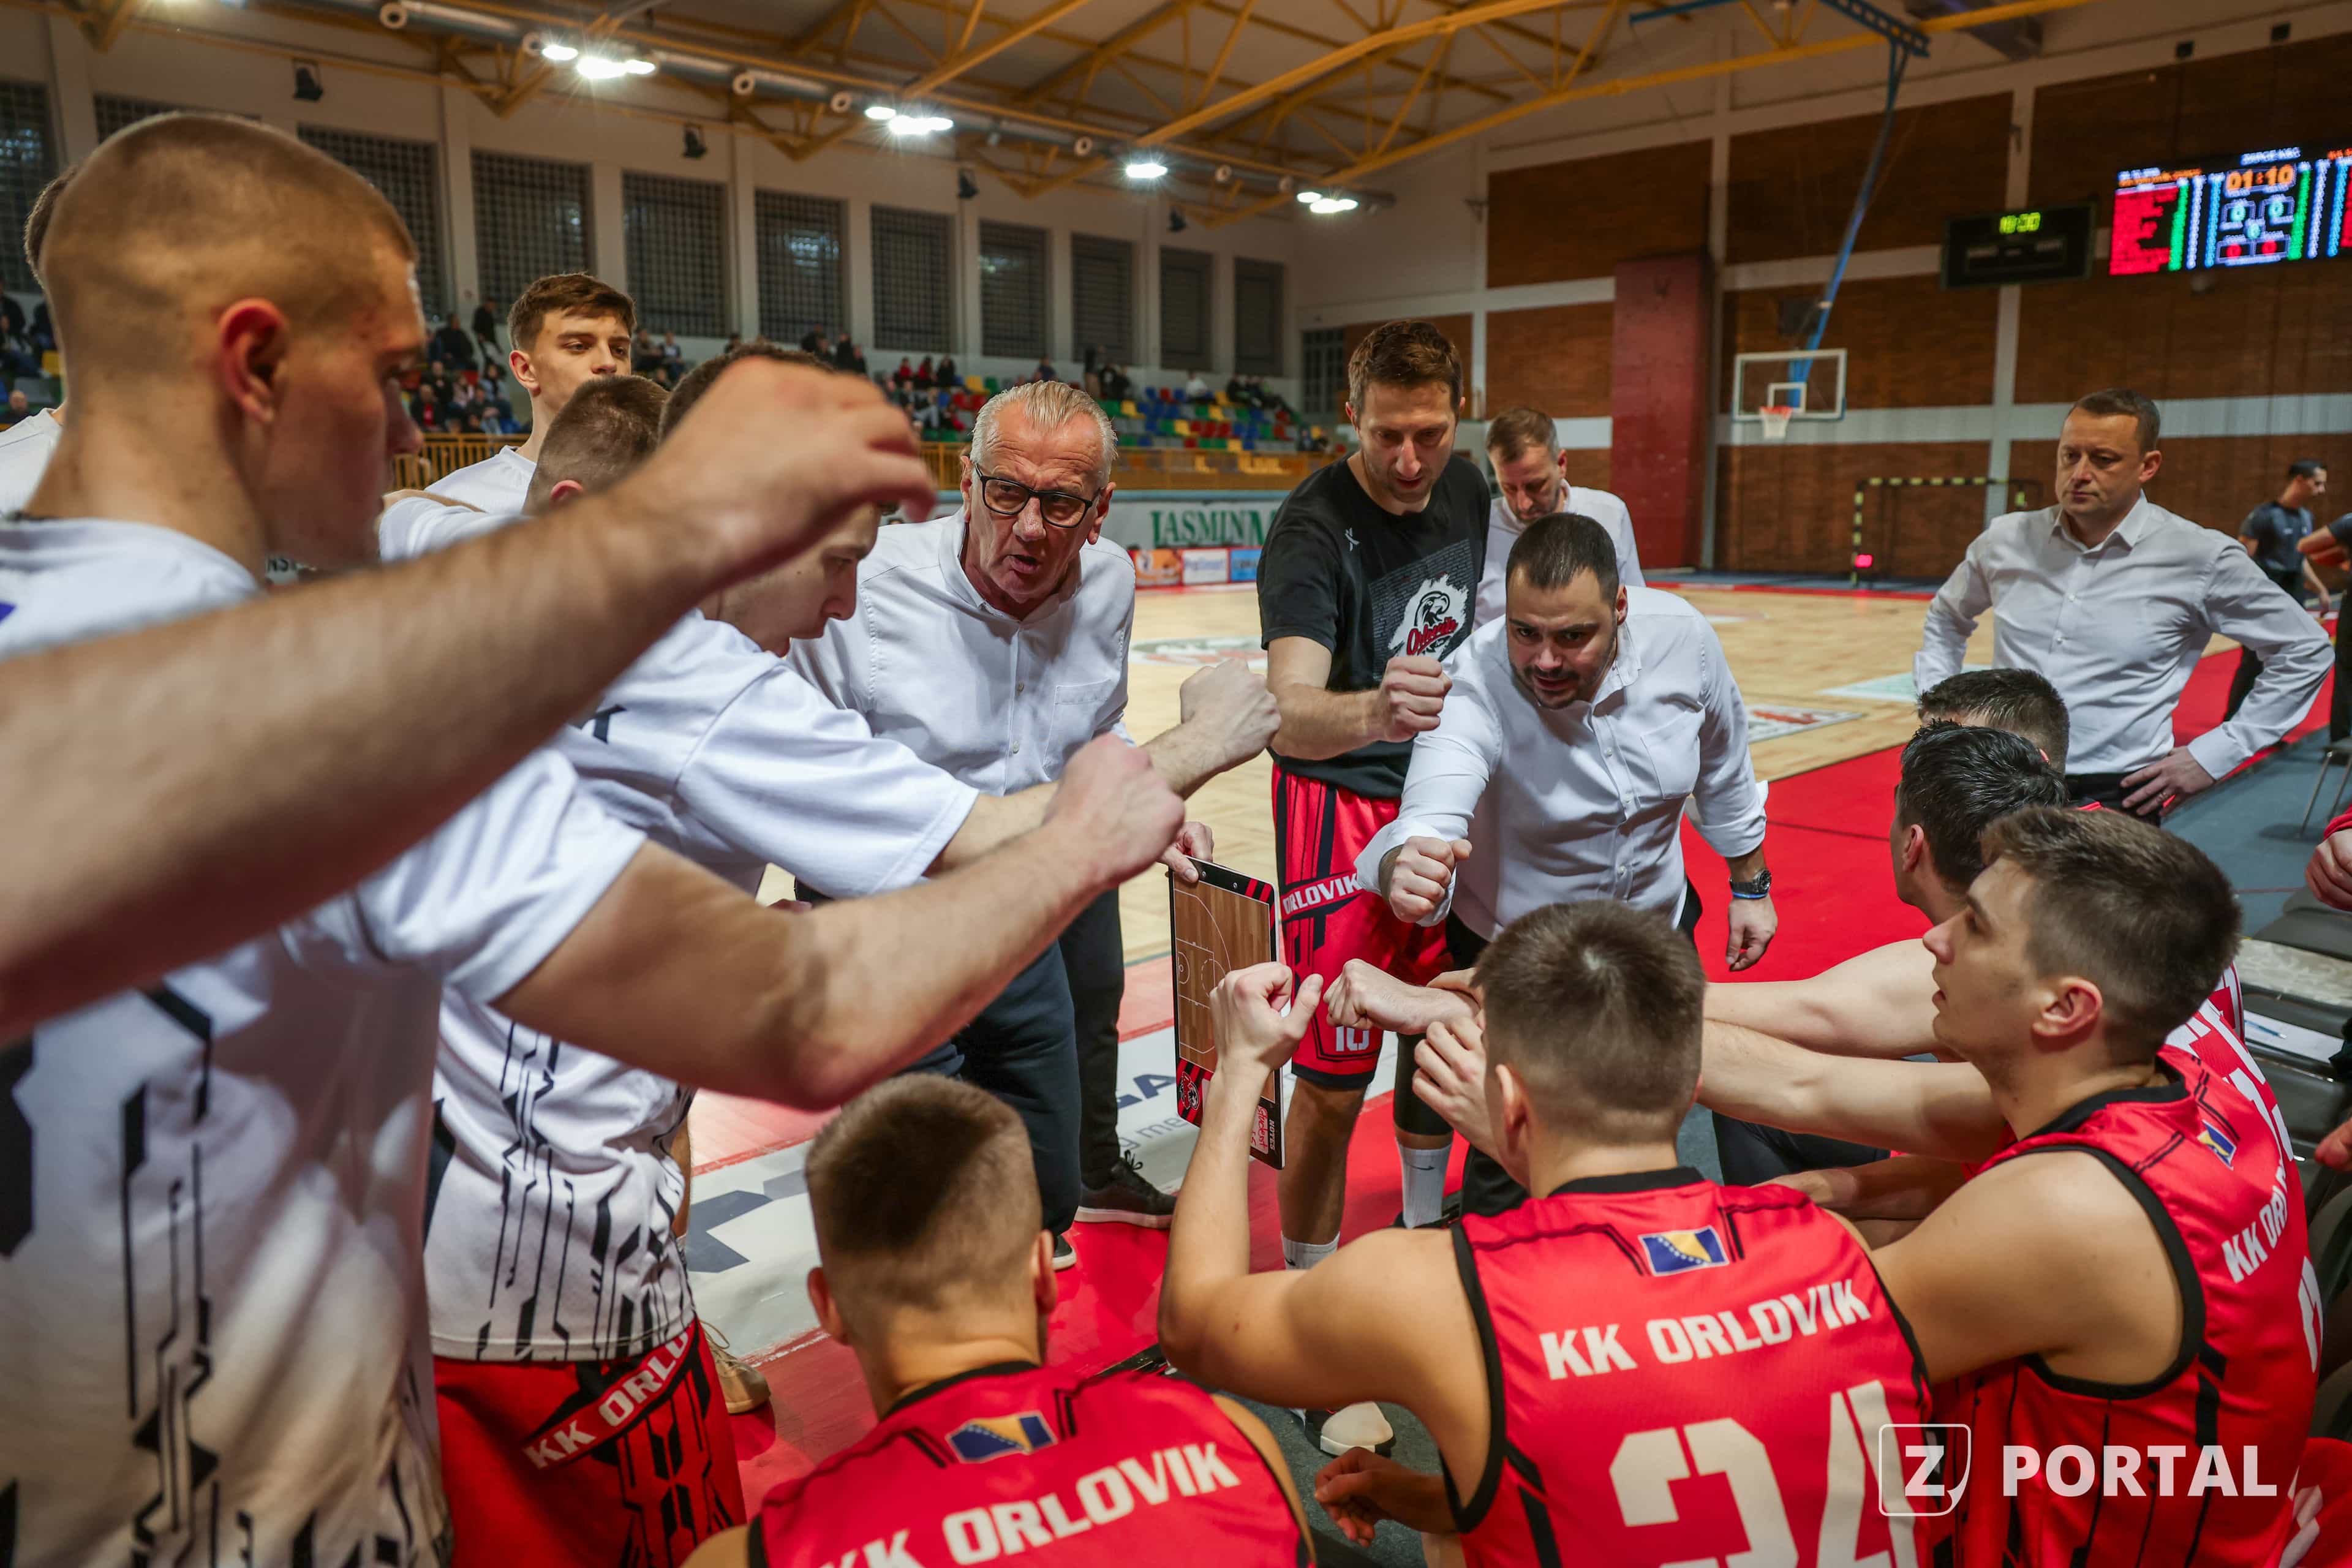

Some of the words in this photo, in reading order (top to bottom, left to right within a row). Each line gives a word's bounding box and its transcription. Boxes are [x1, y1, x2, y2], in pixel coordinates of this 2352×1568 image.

[2226, 164, 2294, 191] 01:10
[1283, 873, 1362, 914] ORLOVIK
[2222, 1221, 2268, 1284] KK
[1539, 1324, 1638, 1381] KK
[1646, 1279, 1871, 1364] ORLOVIK
[522, 1420, 596, 1469] KK
[942, 1442, 1242, 1566] ORLOVIK
